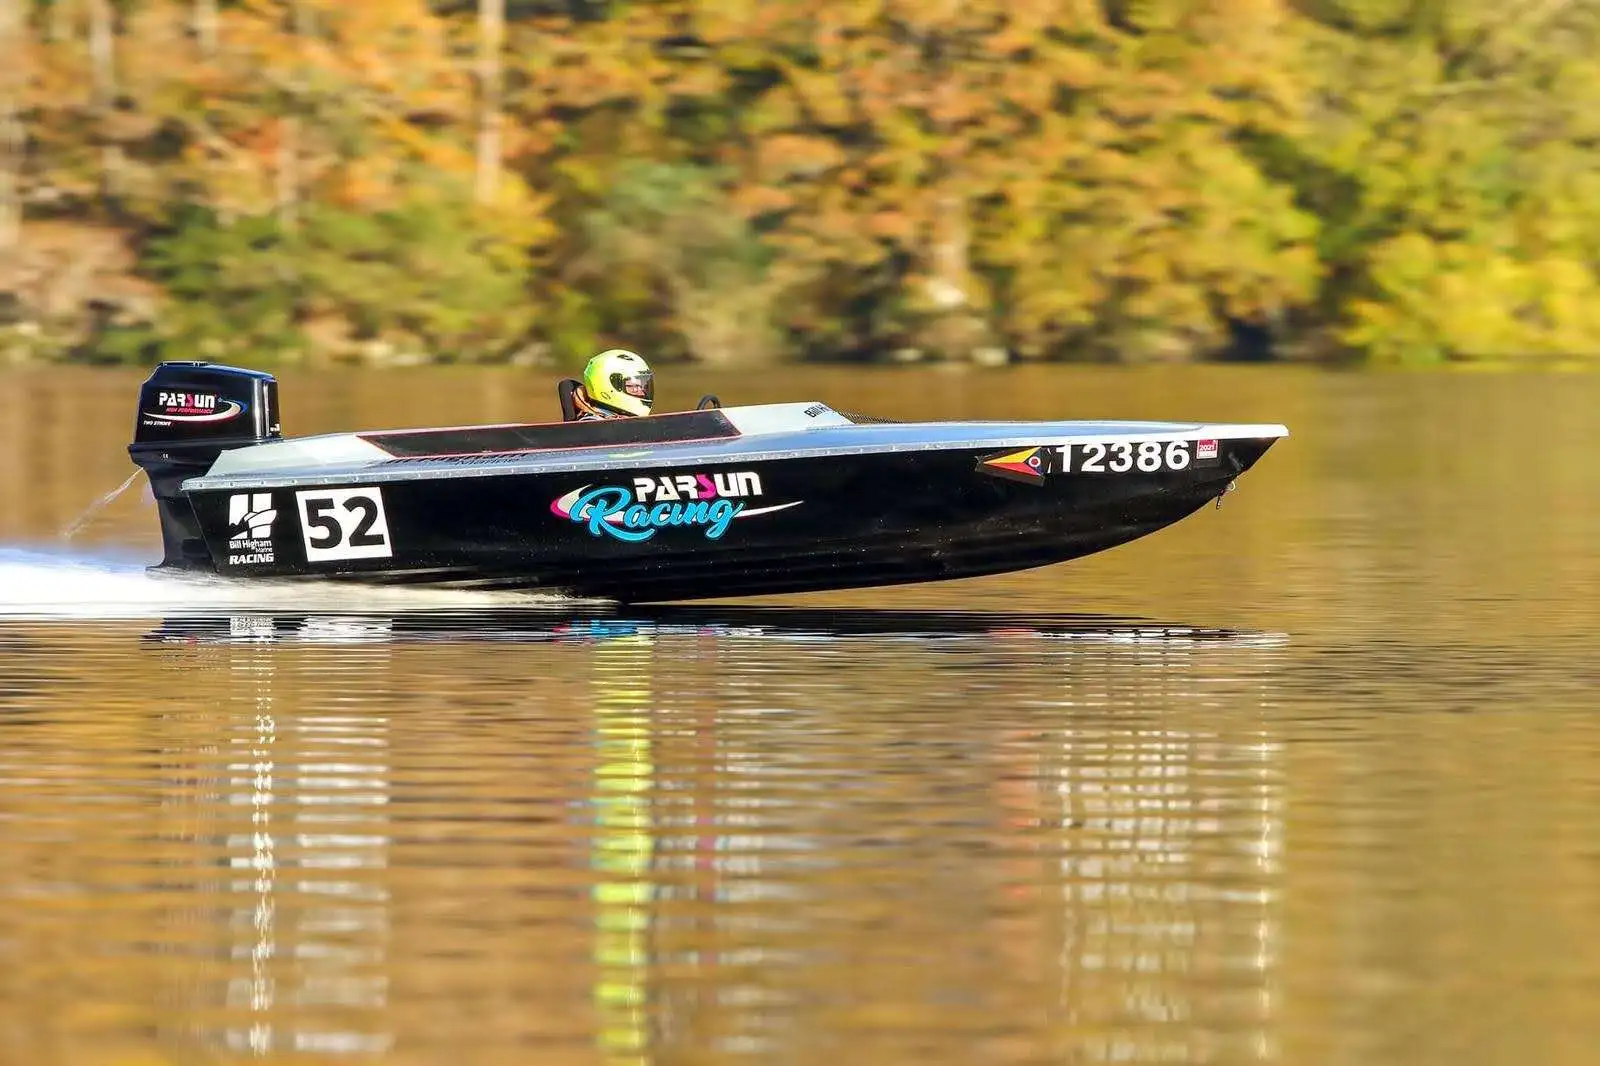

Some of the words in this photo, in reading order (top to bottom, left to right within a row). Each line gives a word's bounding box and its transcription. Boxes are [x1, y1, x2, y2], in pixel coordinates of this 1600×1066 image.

[158, 392, 215, 408] PARSUN
[1055, 439, 1190, 473] 12386
[633, 471, 763, 502] PARSUN
[305, 496, 385, 549] 52
[569, 486, 746, 542] Racing
[229, 540, 242, 549] Bill
[242, 539, 272, 550] Higham
[229, 553, 274, 565] RACING
